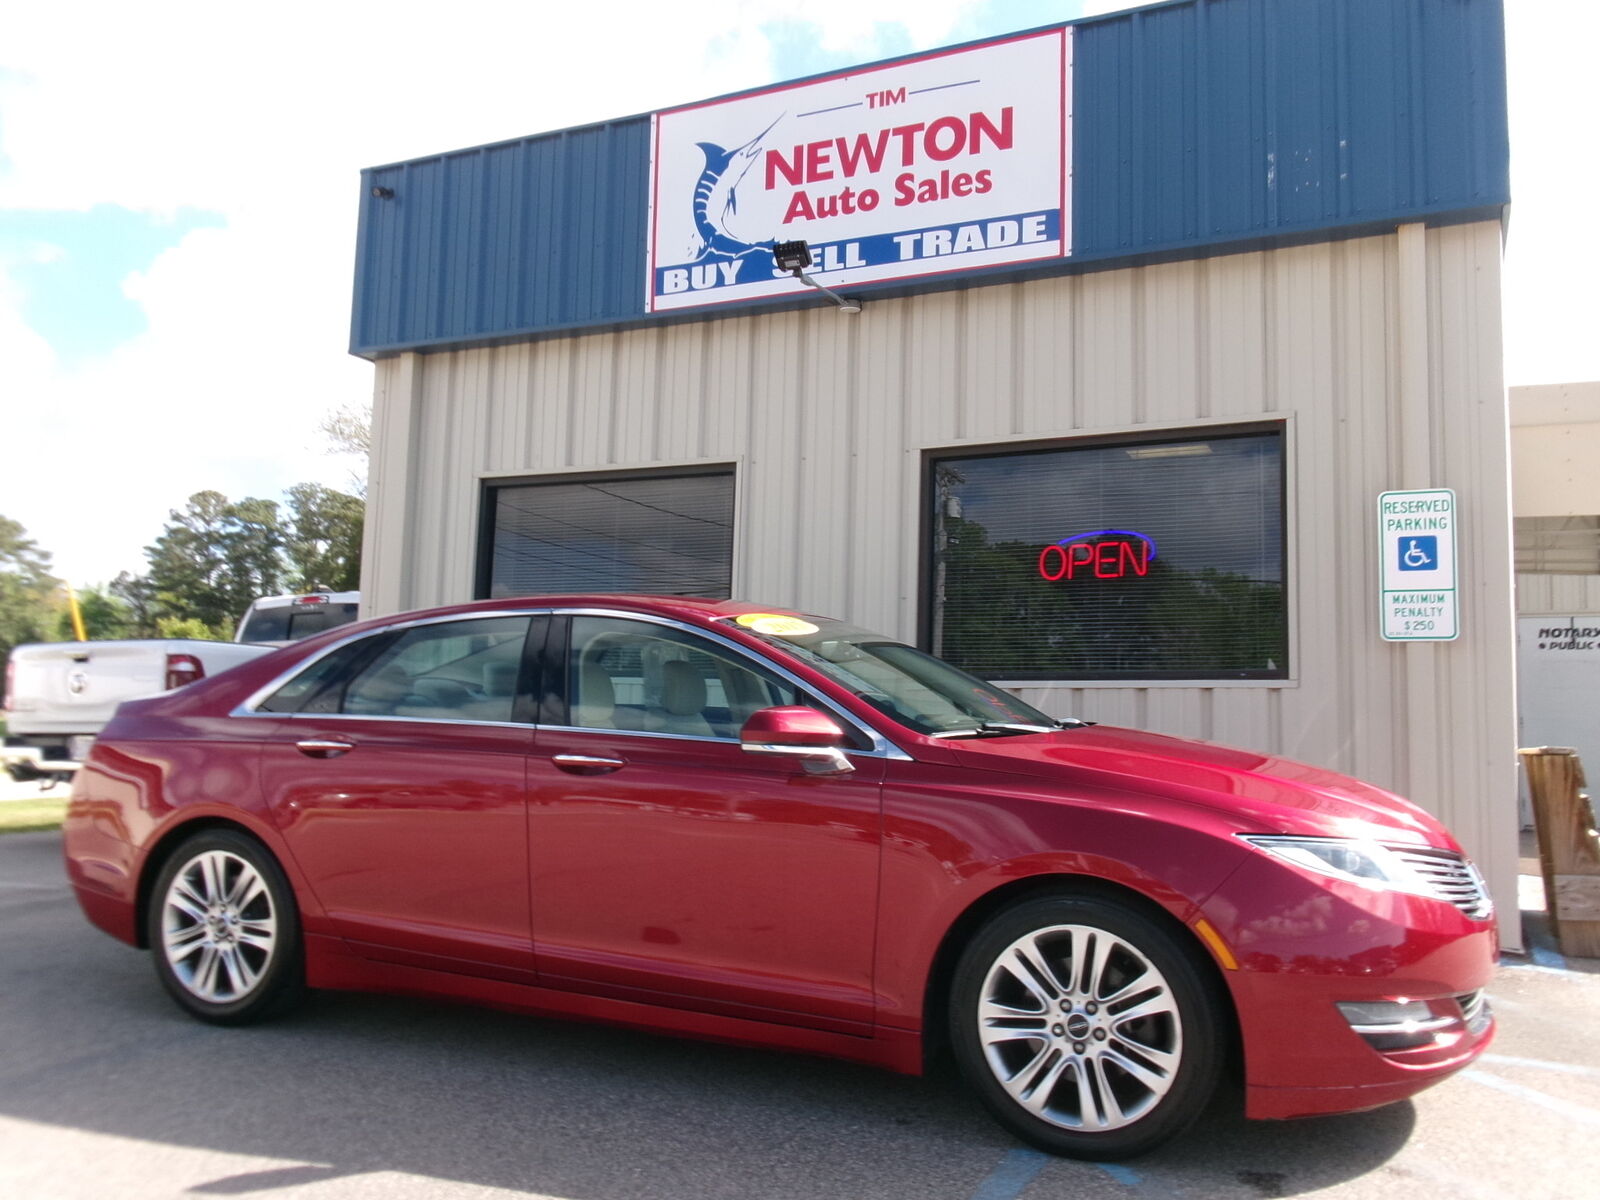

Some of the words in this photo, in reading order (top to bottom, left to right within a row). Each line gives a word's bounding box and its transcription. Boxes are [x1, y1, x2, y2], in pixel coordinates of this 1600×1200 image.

[866, 87, 907, 109] TIM
[764, 106, 1014, 191] NEWTON
[782, 186, 880, 224] Auto
[894, 169, 993, 207] Sales
[662, 259, 743, 294] BUY
[893, 214, 1048, 261] TRADE
[1383, 499, 1450, 515] RESERVED
[1387, 517, 1448, 532] PARKING
[1039, 540, 1149, 581] OPEN
[1392, 594, 1446, 604] MAXIMUM
[1394, 607, 1444, 617] PENALTY
[1548, 641, 1596, 650] PUBLIC
